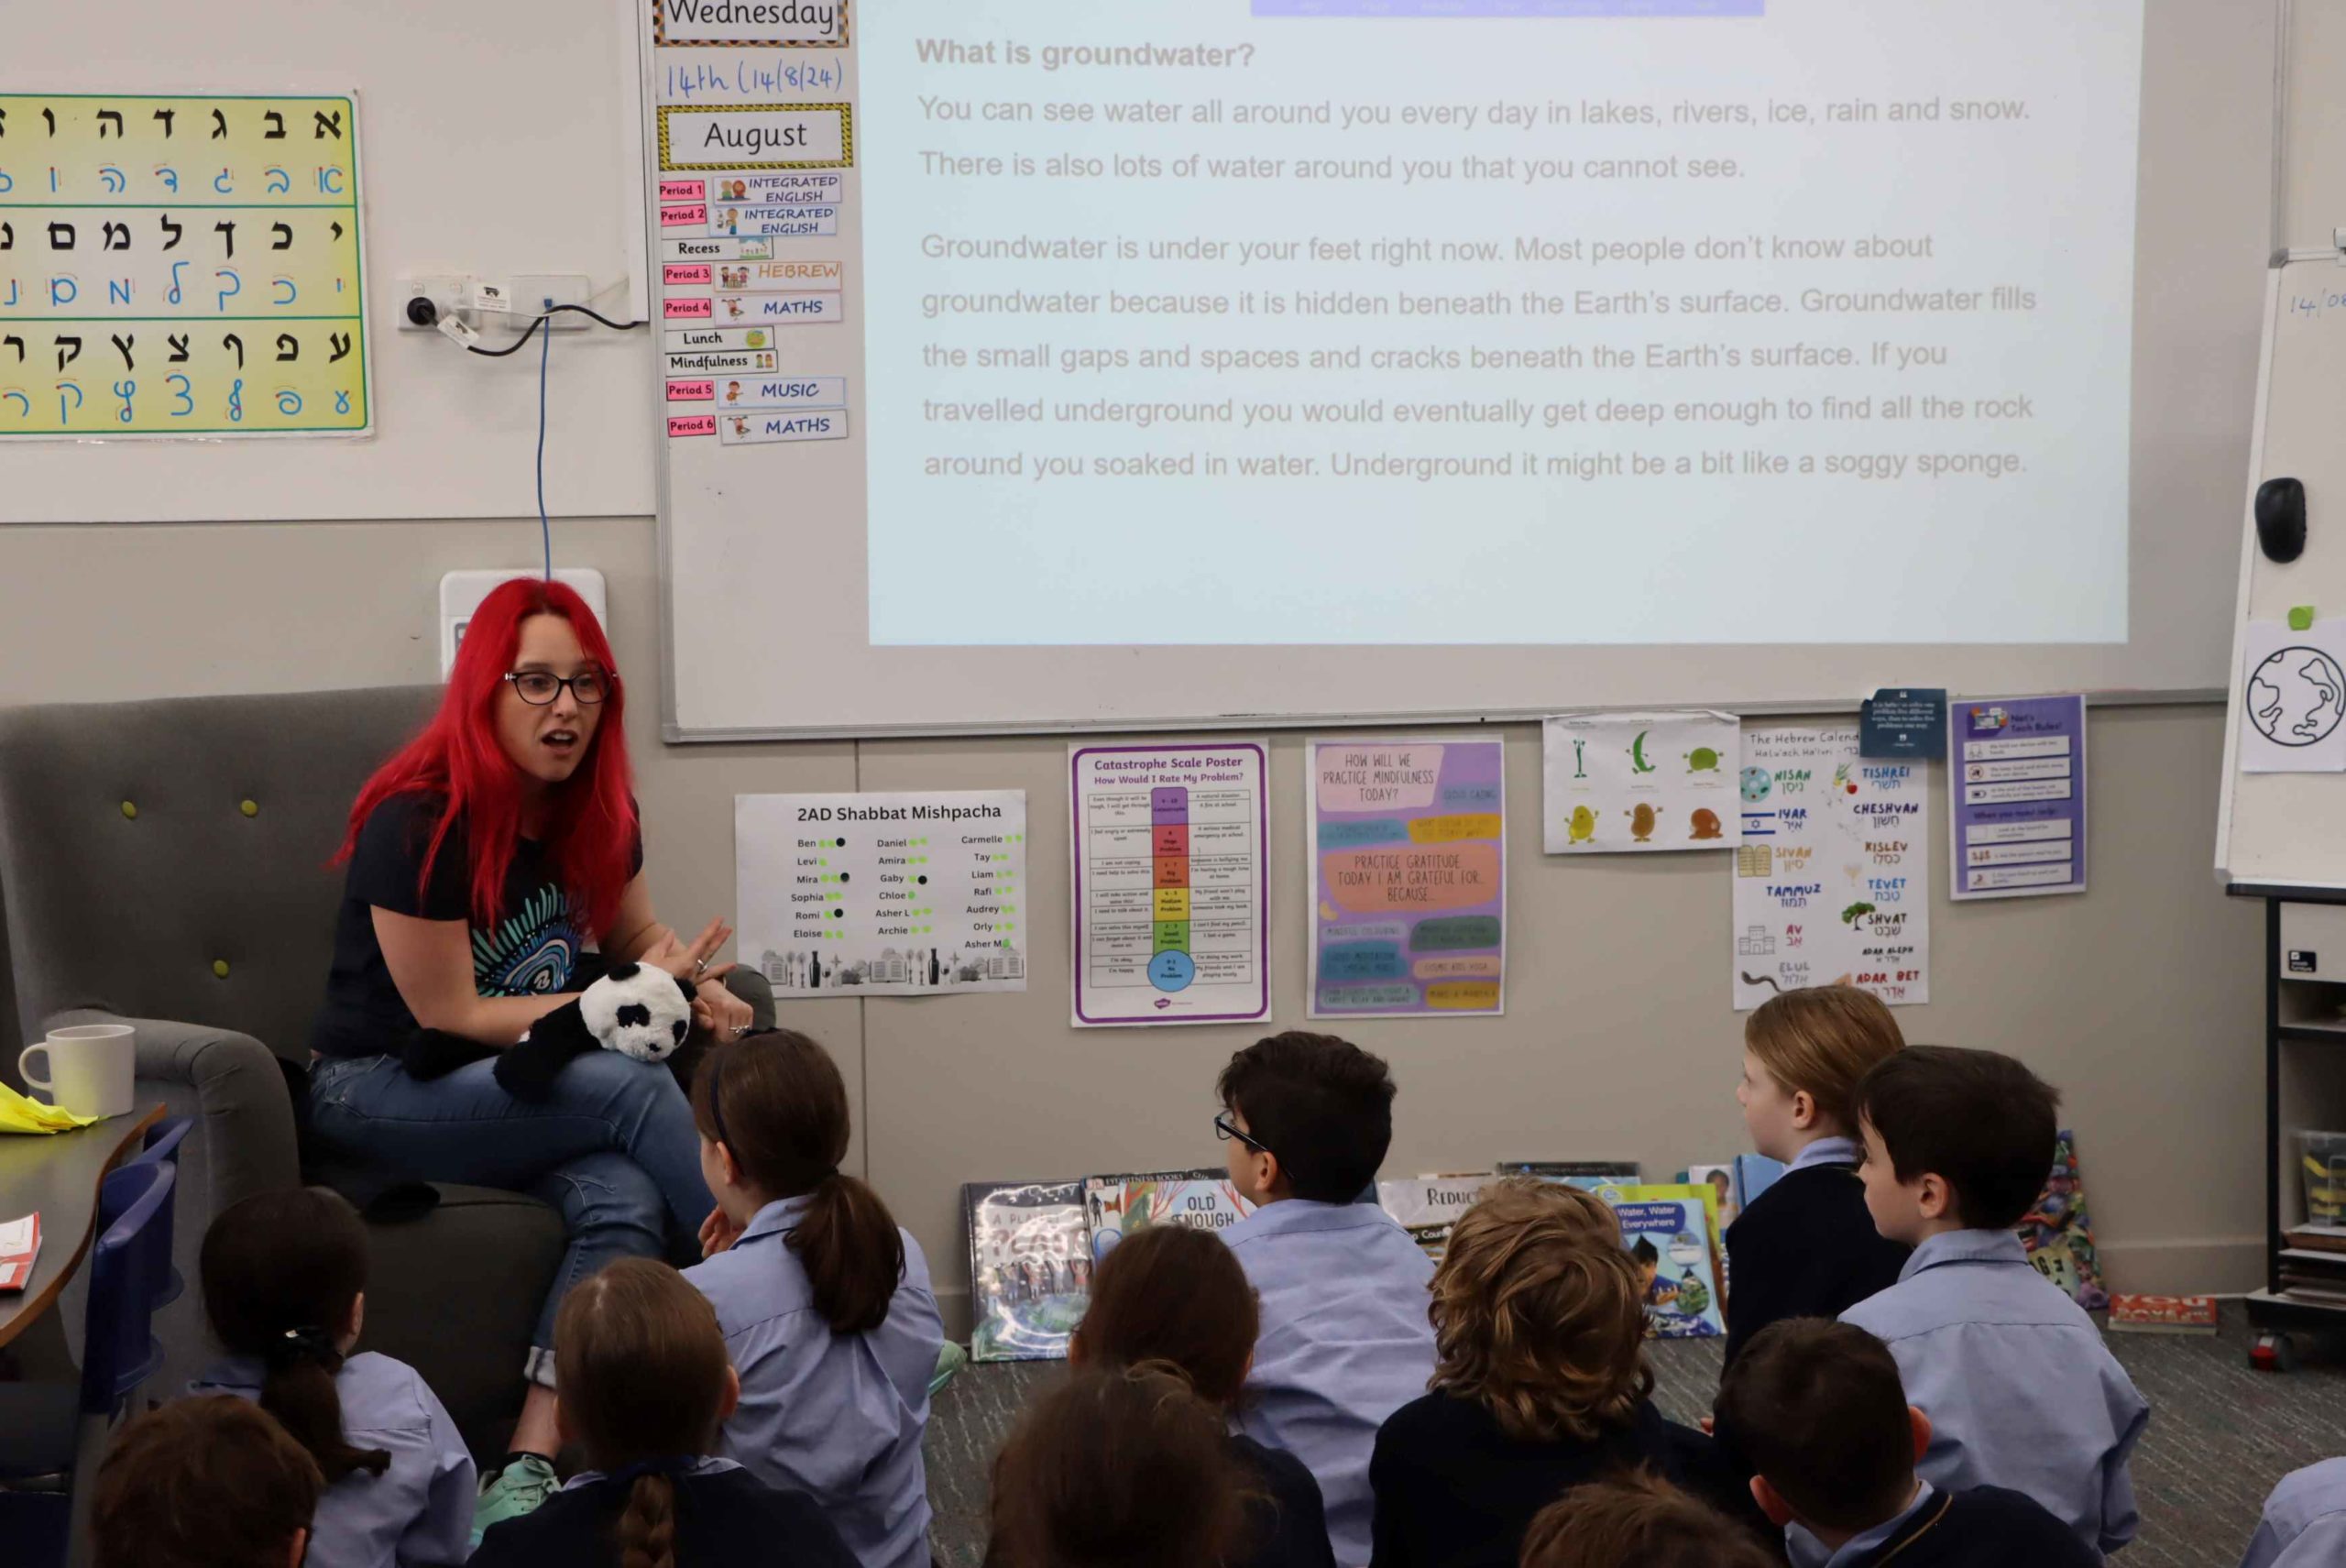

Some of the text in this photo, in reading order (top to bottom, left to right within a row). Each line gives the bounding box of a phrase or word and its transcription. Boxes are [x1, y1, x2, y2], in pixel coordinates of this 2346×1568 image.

[668, 0, 833, 35] Wednesday
[915, 38, 1256, 72] What is groundwater?
[669, 65, 729, 98] 14th
[917, 94, 2030, 132] You can see water all around you every day in lakes, rivers, ice, rain and snow.
[705, 123, 806, 155] August
[917, 149, 1746, 186] There is also lots of water around you that you cannot see.
[750, 177, 838, 189] INTEGRATED
[660, 185, 702, 196] Period 1
[766, 191, 823, 203] ENGLISH
[662, 211, 704, 220] Period 2
[744, 209, 833, 219] INTEGRATED
[762, 223, 818, 234] ENGLISH
[679, 243, 720, 254] Recess
[920, 233, 1934, 269] Groundwater is under your feet right now. Most people don't know about
[666, 269, 709, 280] Period 3
[759, 264, 839, 278] HEBREW
[666, 302, 709, 313] Period 4
[764, 301, 823, 313] MATHS
[684, 333, 722, 345] Lunch
[671, 356, 748, 370] Mindfulness
[669, 385, 711, 395] Period 5
[762, 383, 819, 397] MUSIC
[671, 421, 713, 431] Period 6
[766, 418, 830, 433] MATHS
[1750, 734, 1770, 744] The
[1775, 731, 1815, 743] Hebrew
[1095, 756, 1243, 771] Catastrophe Scale Poster
[1346, 754, 1410, 767] HOW WILL WE
[1323, 770, 1434, 784] PRACTICE MINDFULNESS
[1775, 770, 1811, 782] NISAN
[1862, 767, 1910, 778] TISHREI
[1119, 775, 1148, 784] Would
[1152, 775, 1156, 784] I
[1159, 774, 1180, 783] Rate
[1184, 774, 1197, 784] My
[1200, 773, 1244, 782] Problem?
[1360, 788, 1398, 802] TODAY?
[797, 805, 1002, 822] 2AD Shabbat Mishpacha
[1854, 803, 1919, 815] CHESHVAN
[797, 839, 816, 848] Ben
[877, 839, 906, 848] Daniel
[961, 835, 1003, 844] Carmelle
[1865, 841, 1908, 852] KISLEV
[974, 852, 991, 863] Tay
[1775, 847, 1812, 858] SIVAN
[797, 857, 817, 866] Levi
[878, 856, 905, 865] Amira
[1354, 855, 1460, 869] PRACTICE GRATITUDE
[796, 875, 818, 883] Mira
[880, 874, 904, 884] Gaby
[971, 870, 993, 879] Liam
[1339, 872, 1371, 885] TODAY
[1387, 872, 1401, 885] AM
[1408, 871, 1454, 884] GRATEFUL
[1767, 883, 1821, 896] TAMMUZ
[1868, 878, 1906, 890] TEVET
[879, 891, 906, 900] Chloe
[974, 887, 992, 897] Rafi
[791, 893, 824, 903] Sophia
[795, 911, 820, 920] Romi
[875, 909, 910, 917] Asher L
[967, 905, 999, 916] Audrey
[1868, 913, 1907, 925] SHVAT
[878, 926, 908, 936] Archie
[973, 922, 992, 932] Orly
[1786, 925, 1803, 935] AV
[794, 929, 822, 938] Eloise
[965, 939, 1002, 948] Asher M
[1780, 961, 1810, 972] ELUL
[1857, 970, 1919, 983] ADAR BET
[1188, 1196, 1216, 1212] OLD
[1649, 1206, 1676, 1215] Water
[1622, 1219, 1675, 1230] Everywhere
